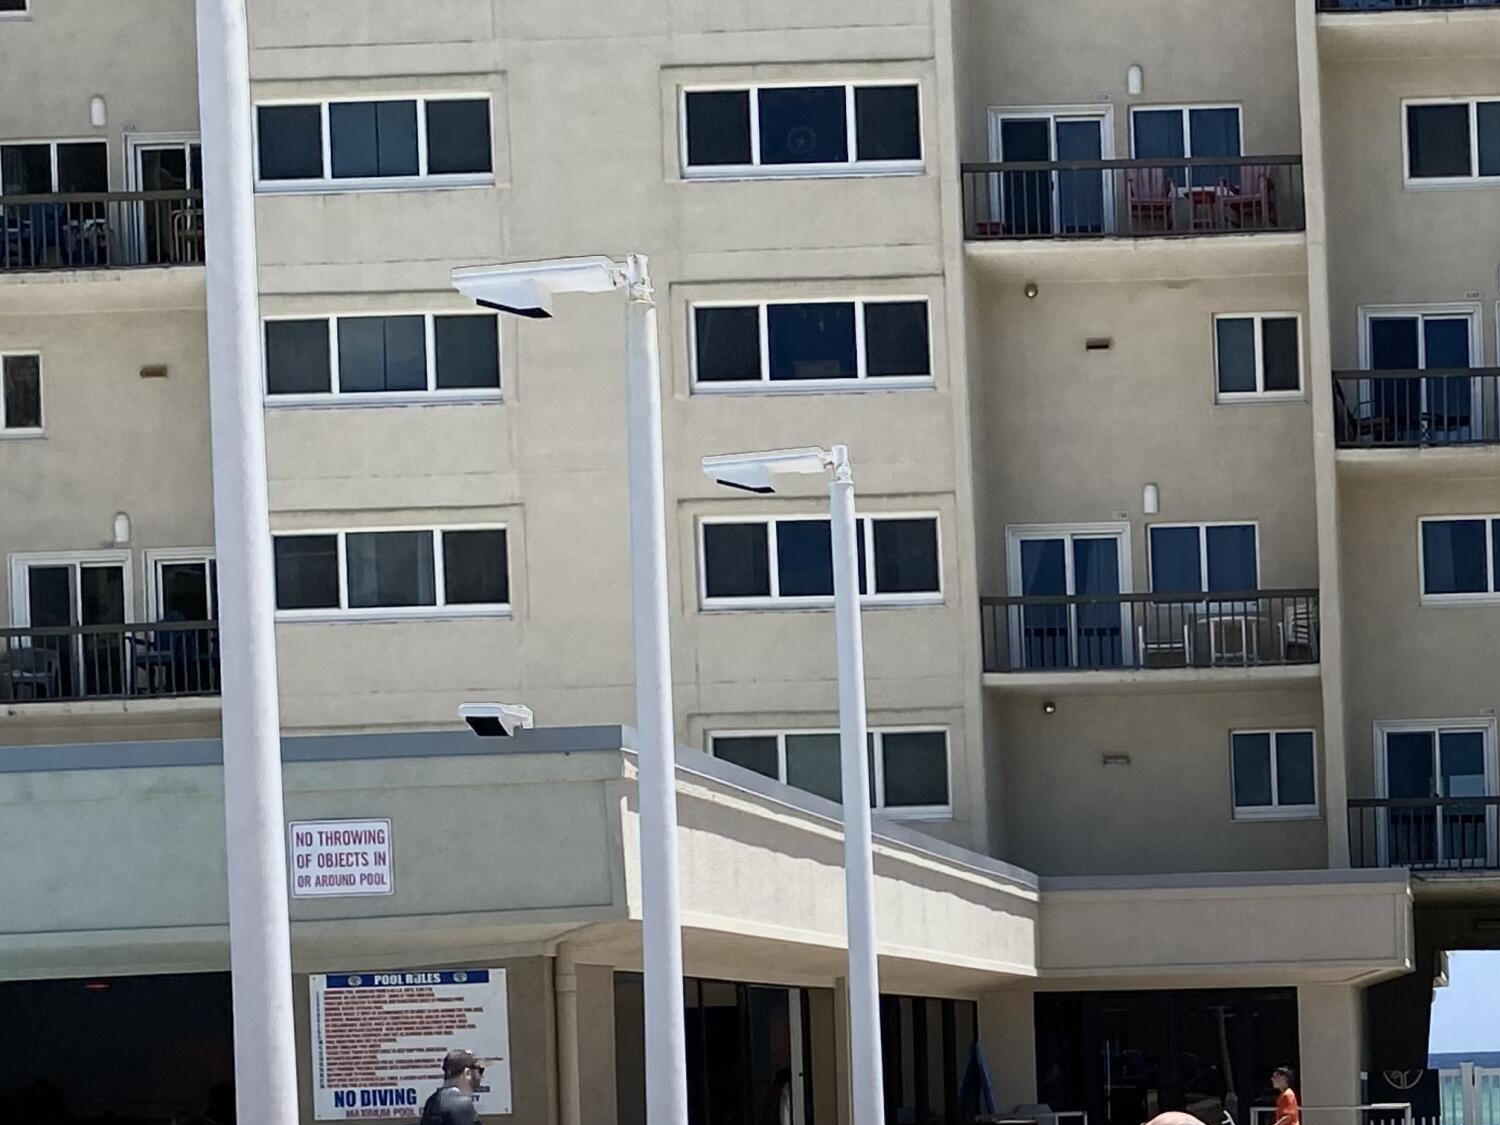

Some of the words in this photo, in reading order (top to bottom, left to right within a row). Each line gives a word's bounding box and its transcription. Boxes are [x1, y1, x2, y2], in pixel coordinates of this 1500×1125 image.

[295, 831, 313, 847] NO
[317, 829, 386, 846] THROWING
[296, 853, 312, 869] OF
[317, 852, 369, 868] OBJECTS
[374, 851, 386, 866] IN
[297, 875, 312, 888] OR
[315, 873, 356, 887] AROUND
[360, 872, 387, 886] POOL
[374, 974, 403, 985] POOL
[405, 973, 441, 984] RULES
[334, 1089, 356, 1108] NO
[360, 1088, 417, 1108] DIVING
[393, 1107, 415, 1118] POOL
